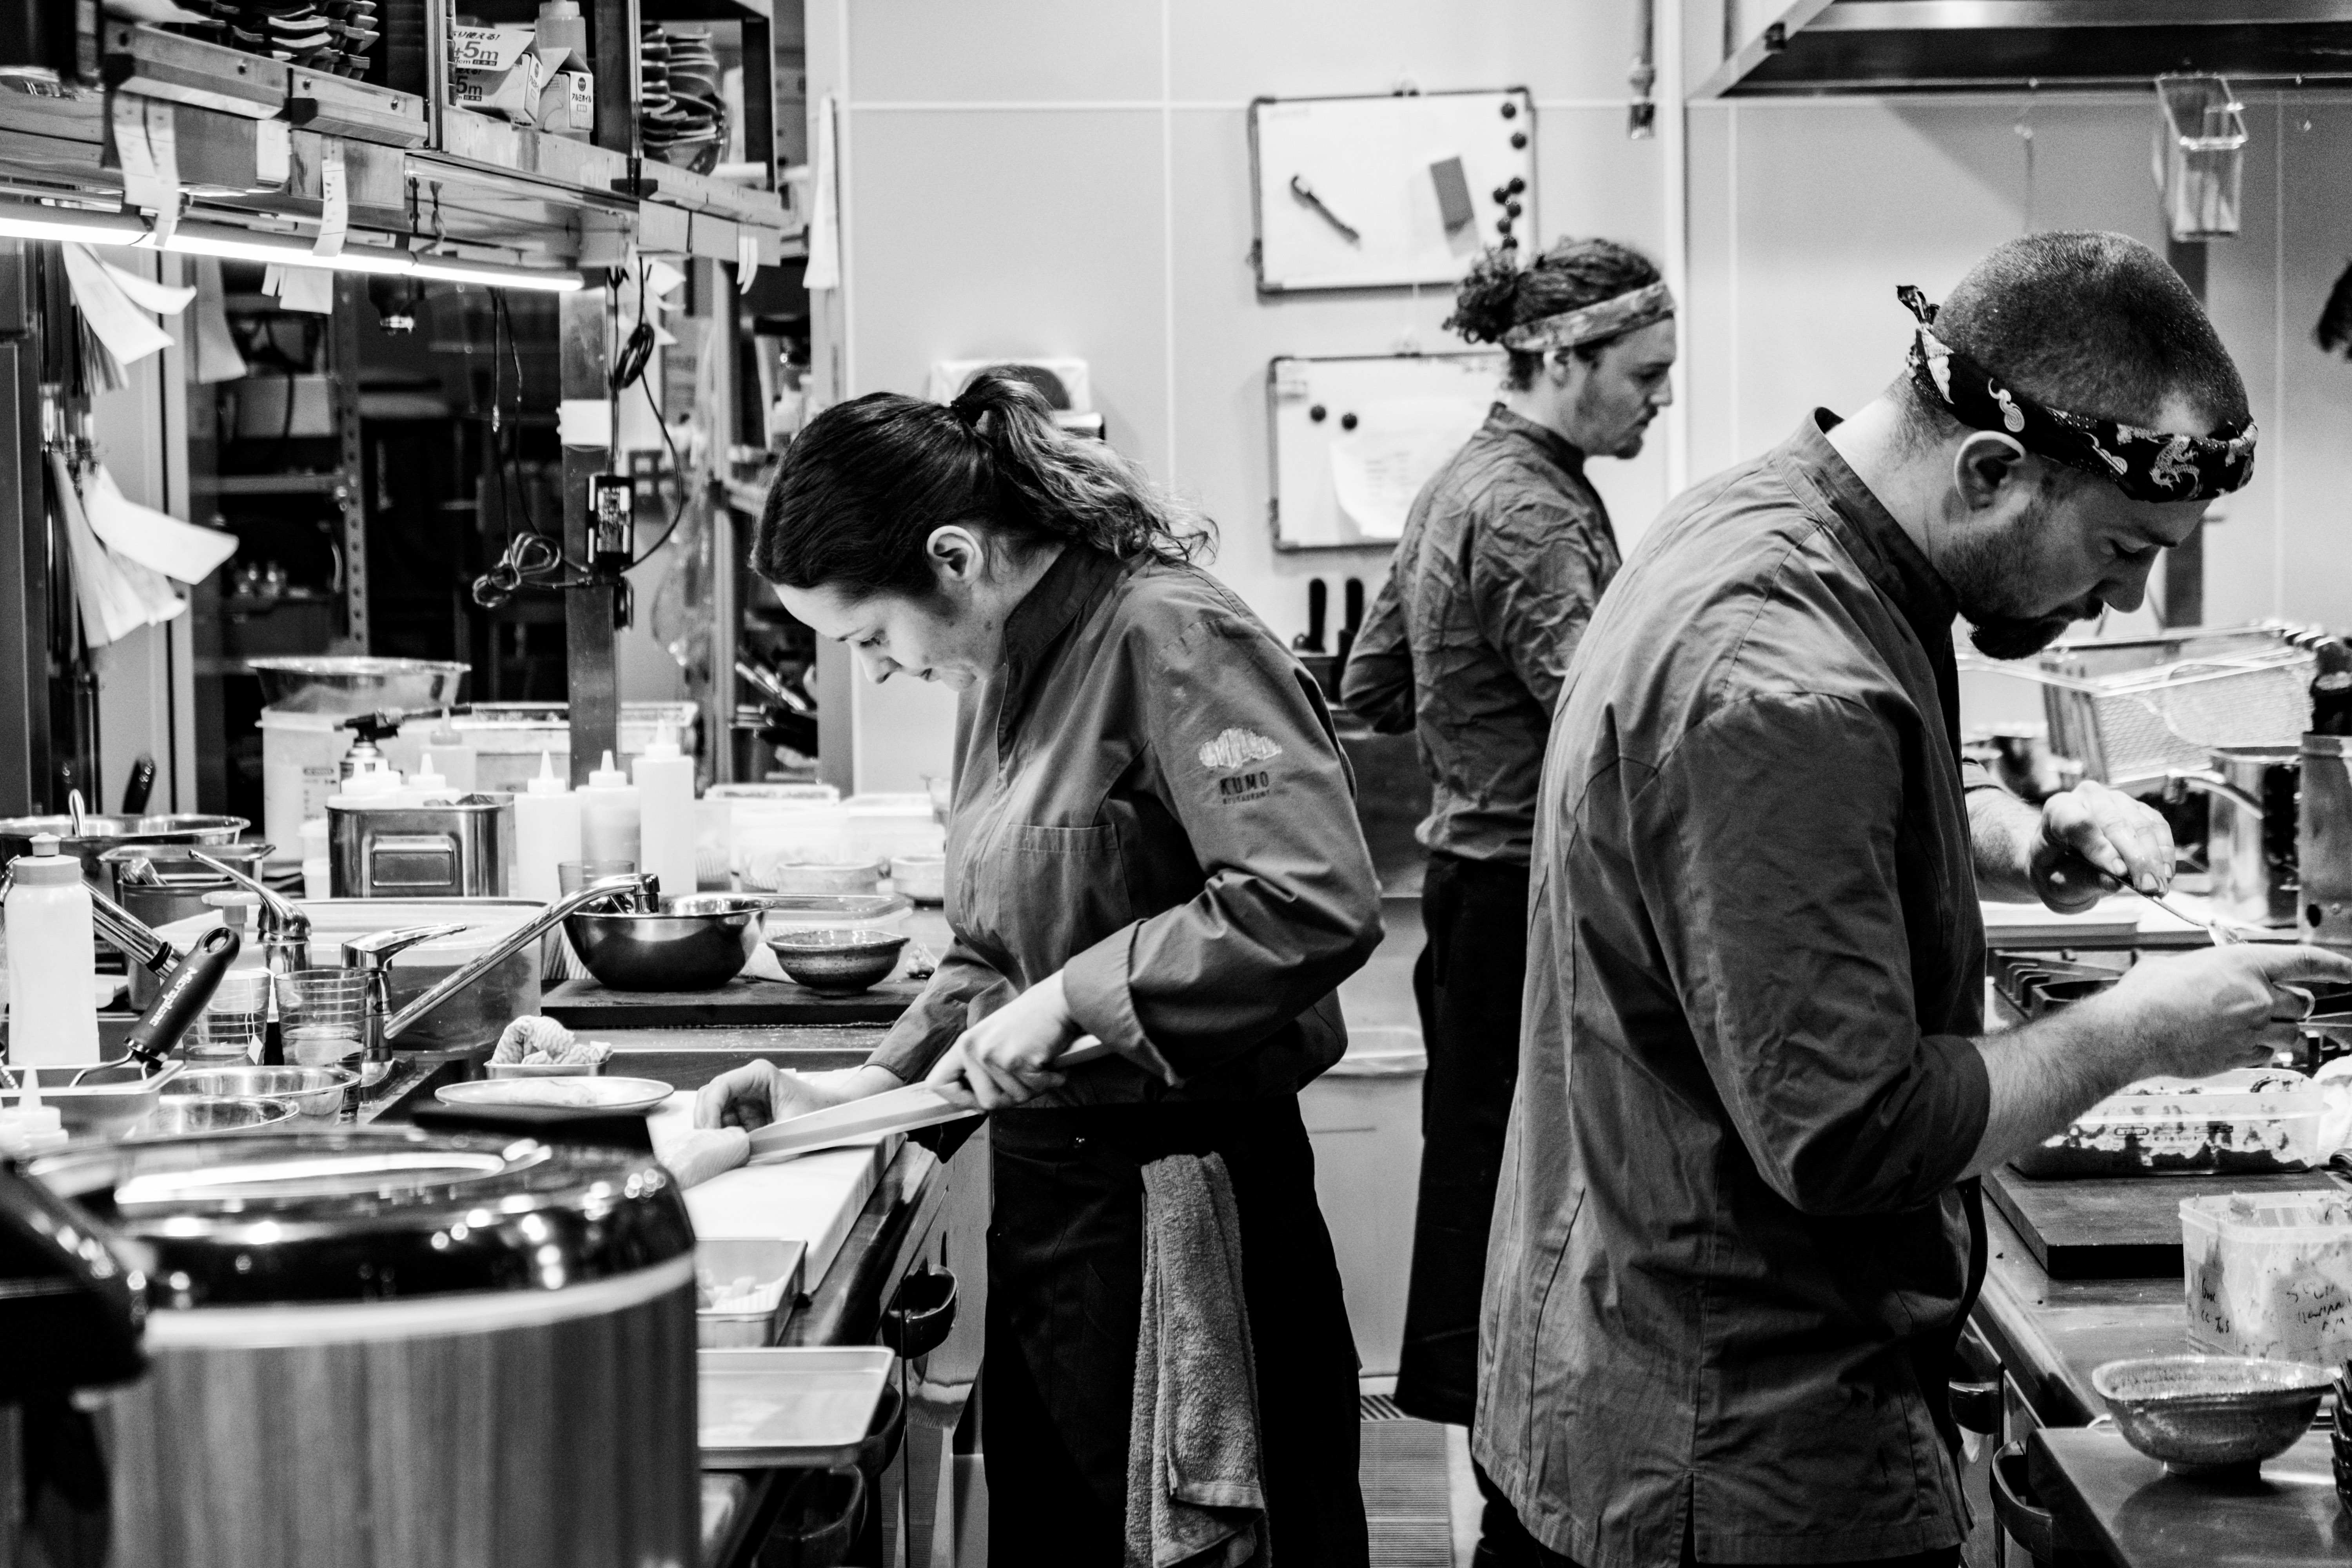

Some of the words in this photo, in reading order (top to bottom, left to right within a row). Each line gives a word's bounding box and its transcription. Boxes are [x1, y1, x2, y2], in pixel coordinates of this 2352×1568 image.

[572, 93, 592, 103] アルミホイル
[1220, 771, 1269, 795] KUMO
[149, 967, 198, 1027] Microplane
